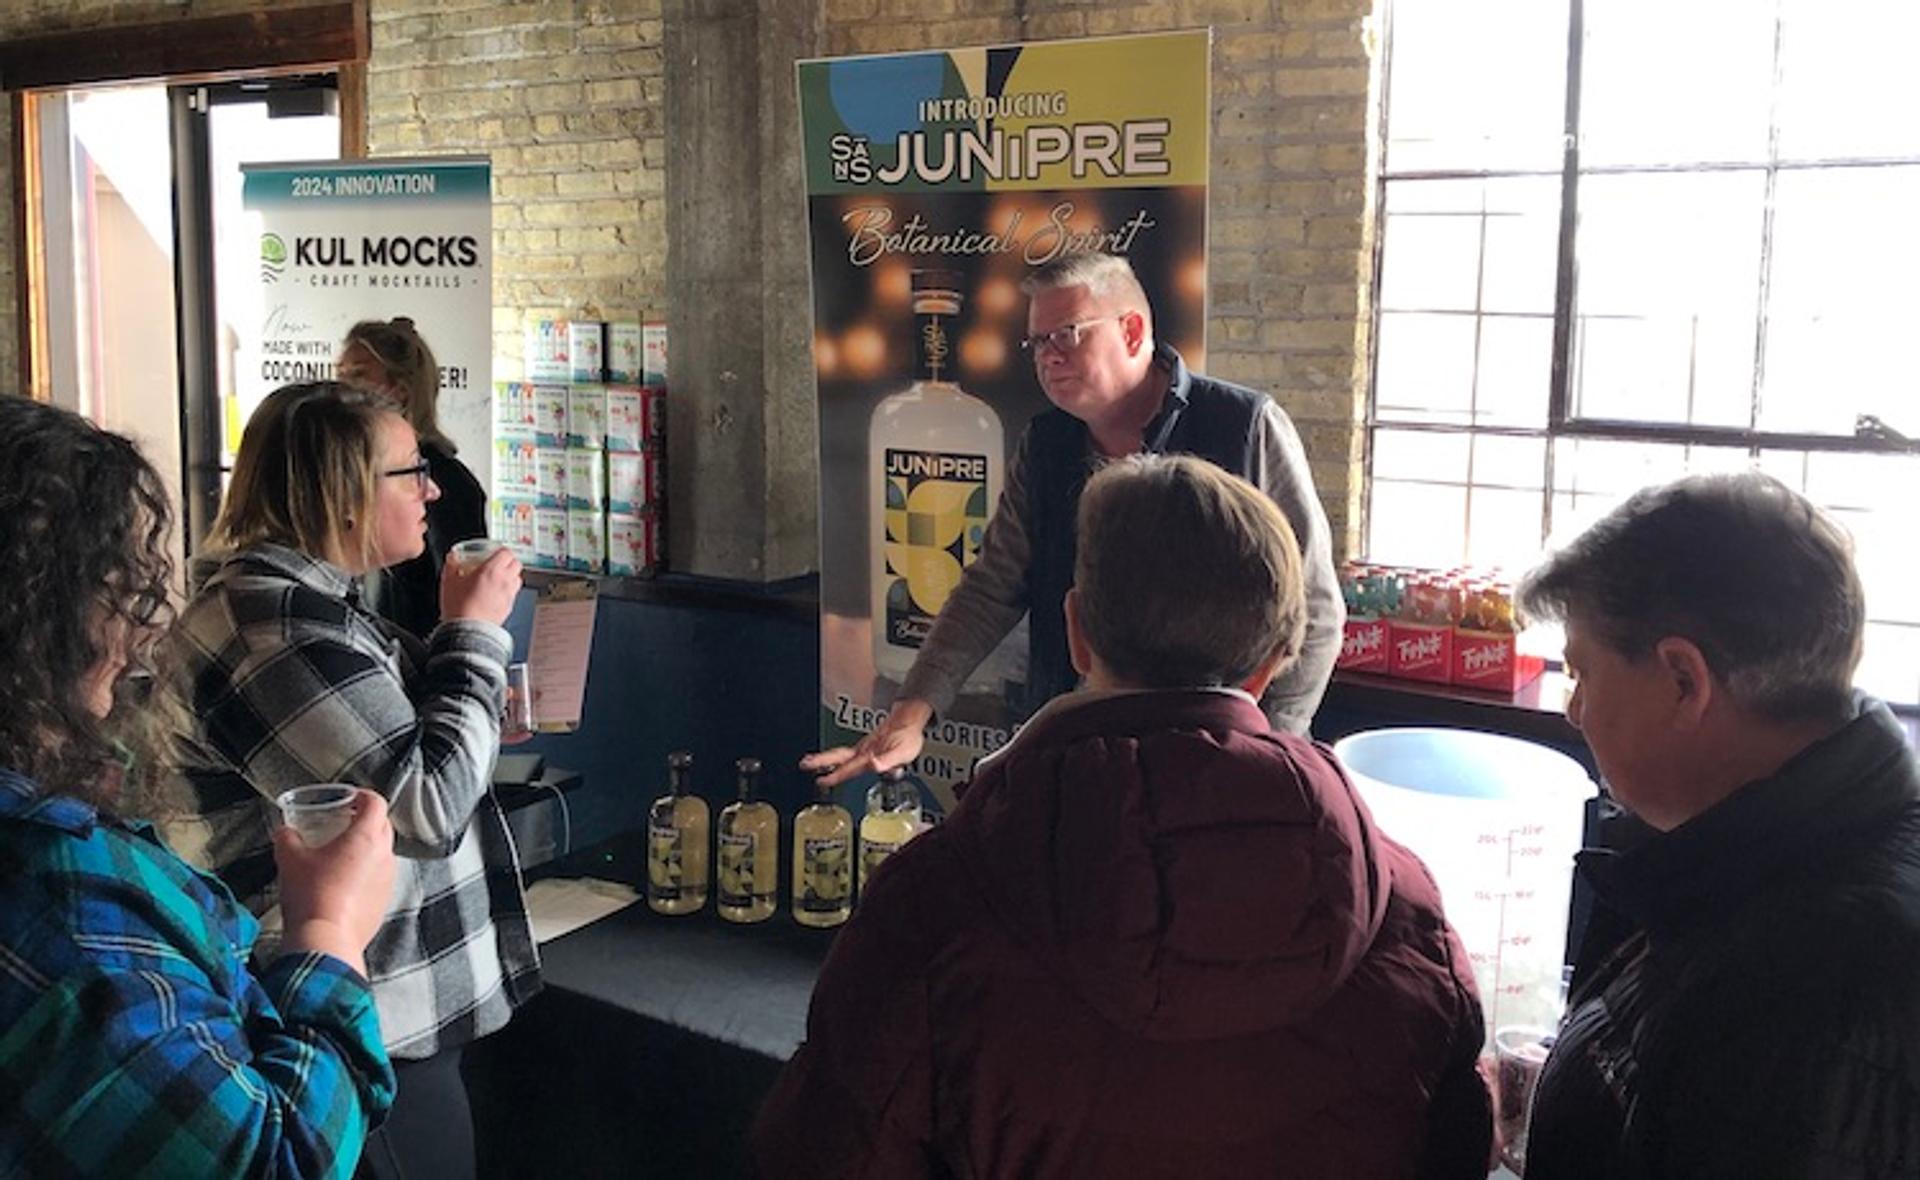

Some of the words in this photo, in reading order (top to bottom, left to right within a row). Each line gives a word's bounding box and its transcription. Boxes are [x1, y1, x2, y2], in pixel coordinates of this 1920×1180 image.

[919, 94, 1067, 122] INTRODUCING
[291, 178, 333, 197] 2024
[335, 174, 435, 196] INNOVATION
[842, 206, 1023, 266] Botanical
[1023, 201, 1155, 266] Spirit
[295, 236, 355, 267] KUL
[362, 235, 478, 267] MOCKS
[310, 274, 358, 288] CRAFT
[368, 274, 461, 289] MOCKTAILS
[262, 340, 293, 355] MADE
[296, 340, 332, 356] WITH
[887, 453, 985, 480] JUNIPRE
